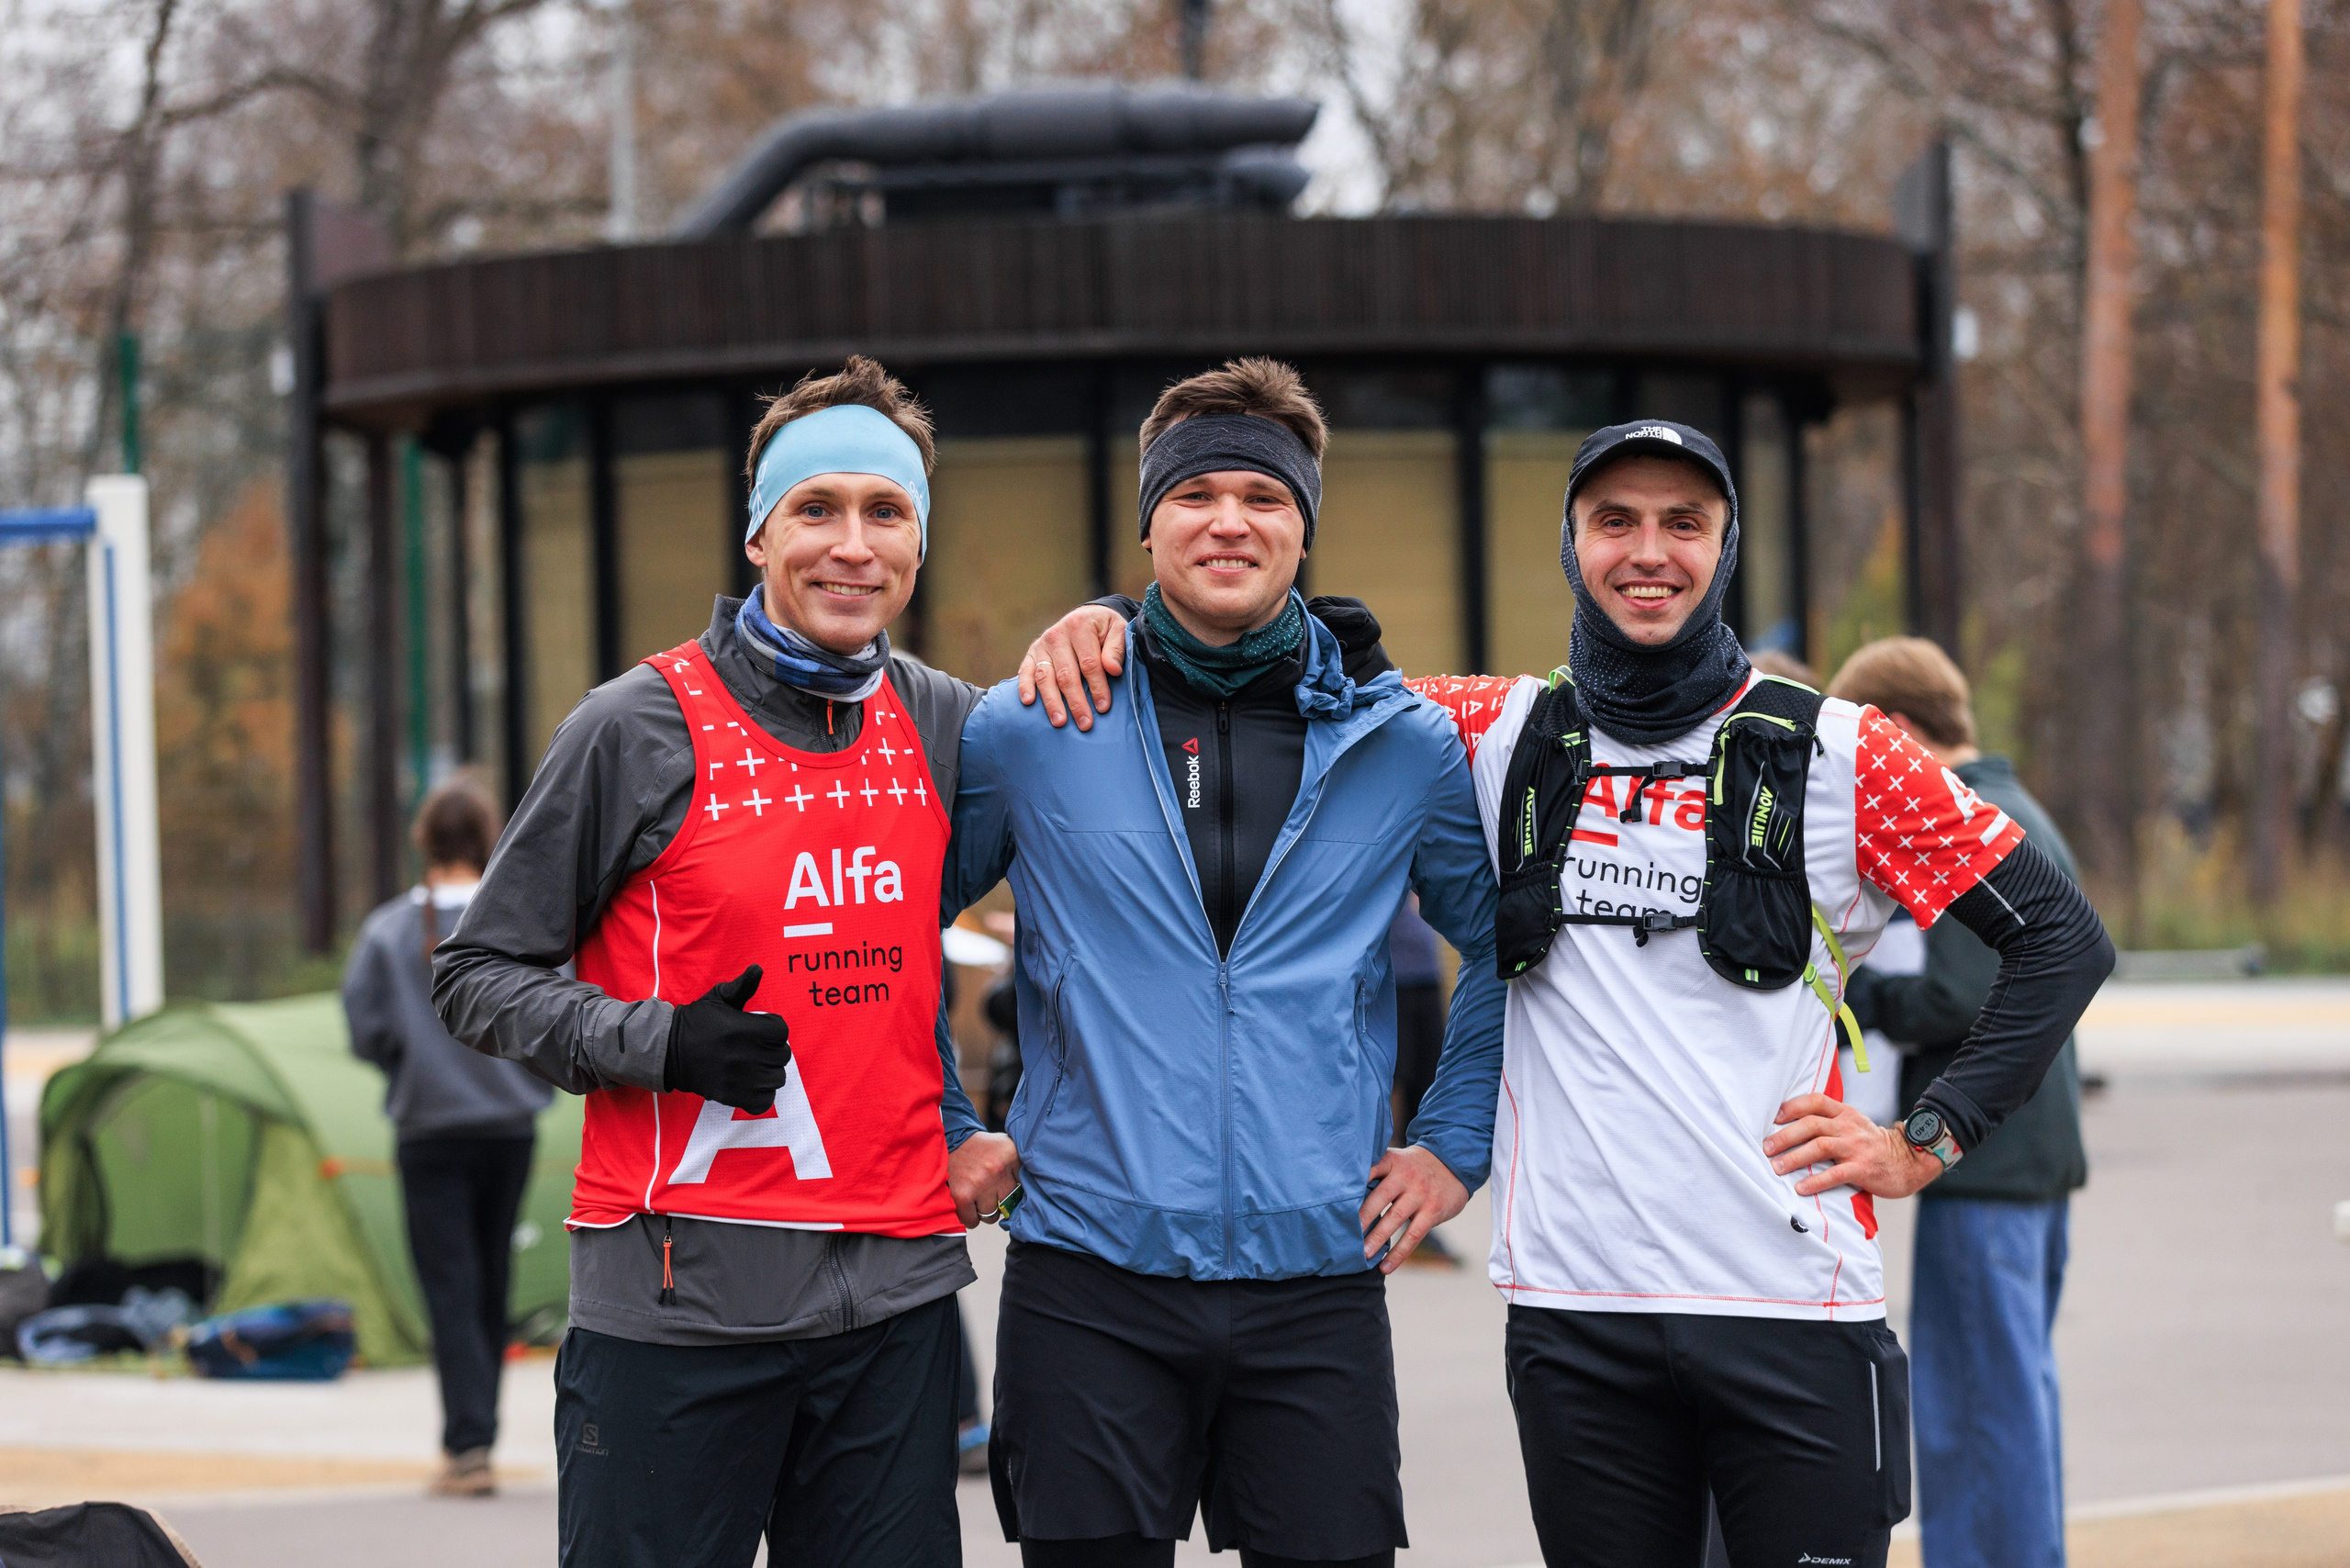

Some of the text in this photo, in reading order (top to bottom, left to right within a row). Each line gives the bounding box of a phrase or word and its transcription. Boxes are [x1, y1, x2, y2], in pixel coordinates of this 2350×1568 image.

[1186, 755, 1201, 808] Reebok
[1751, 785, 1774, 848] AONIJIE
[783, 846, 904, 910] Alfa
[1561, 856, 1704, 904] running
[788, 940, 903, 974] running
[808, 980, 890, 1007] team
[1810, 1556, 1852, 1565] DEMIX
